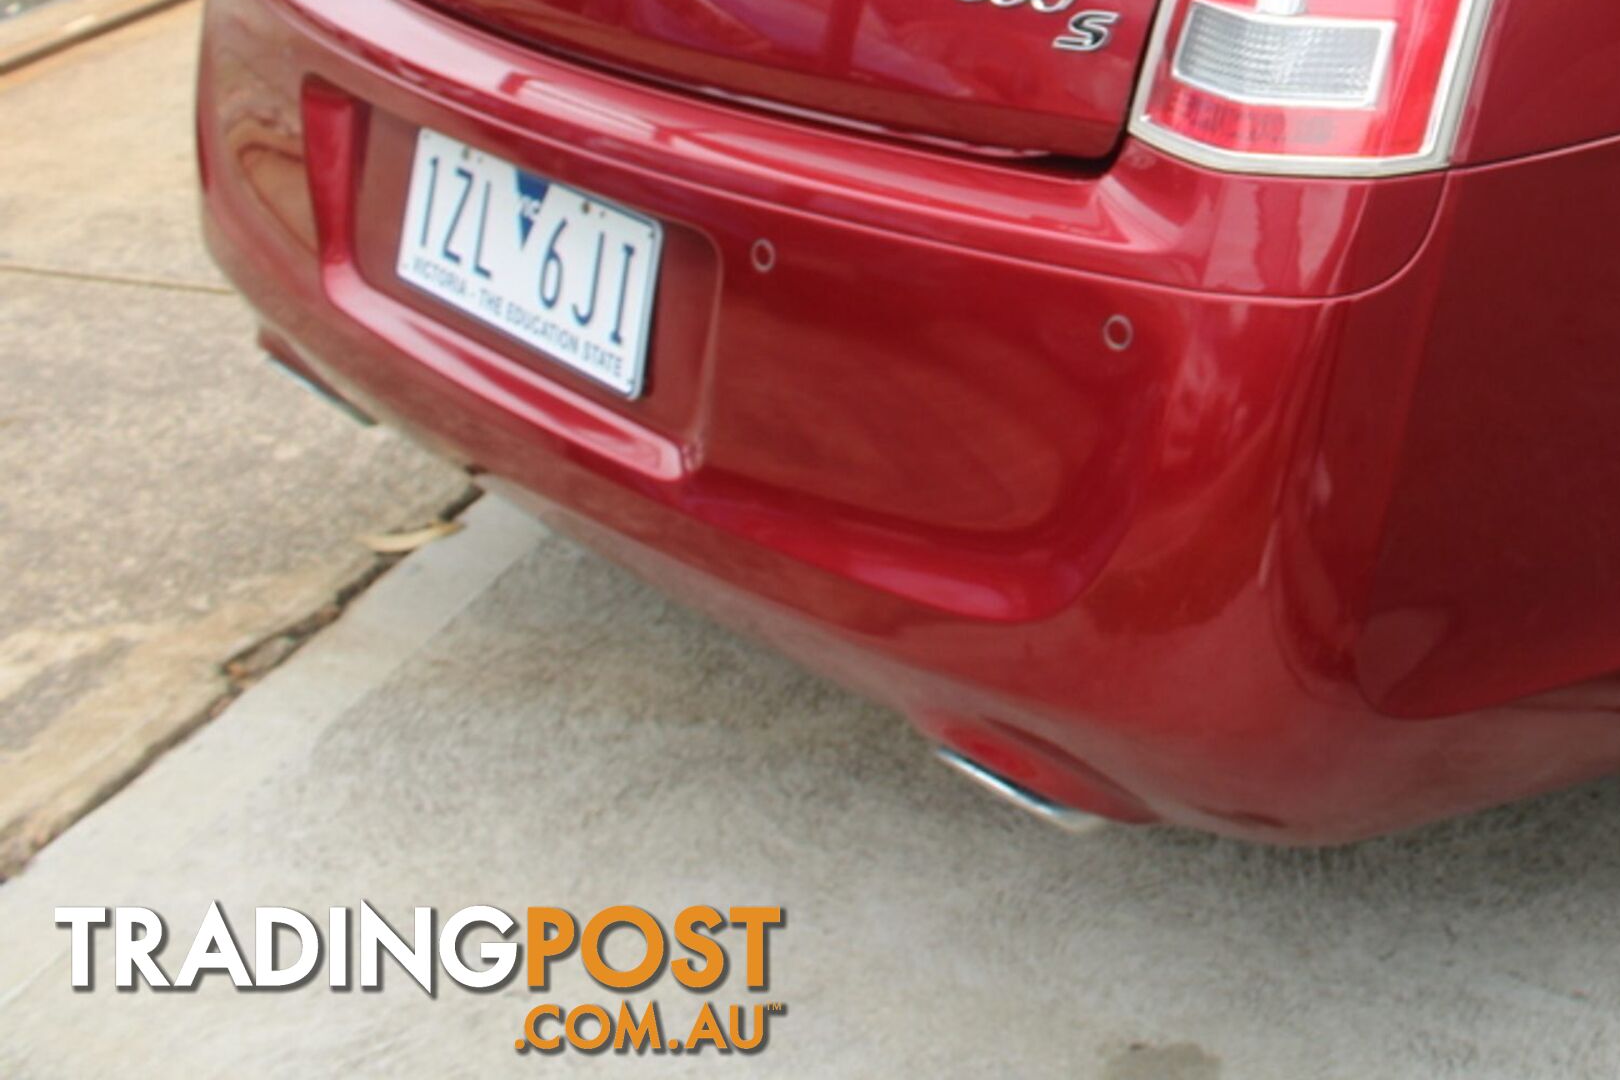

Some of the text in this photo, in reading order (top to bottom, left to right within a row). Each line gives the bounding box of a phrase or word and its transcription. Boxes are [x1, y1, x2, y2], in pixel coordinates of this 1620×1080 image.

[1052, 9, 1120, 51] S
[412, 256, 468, 298] VICTORIA
[478, 287, 503, 317] THE
[505, 300, 579, 351] EDUCATION
[582, 339, 624, 378] STATE
